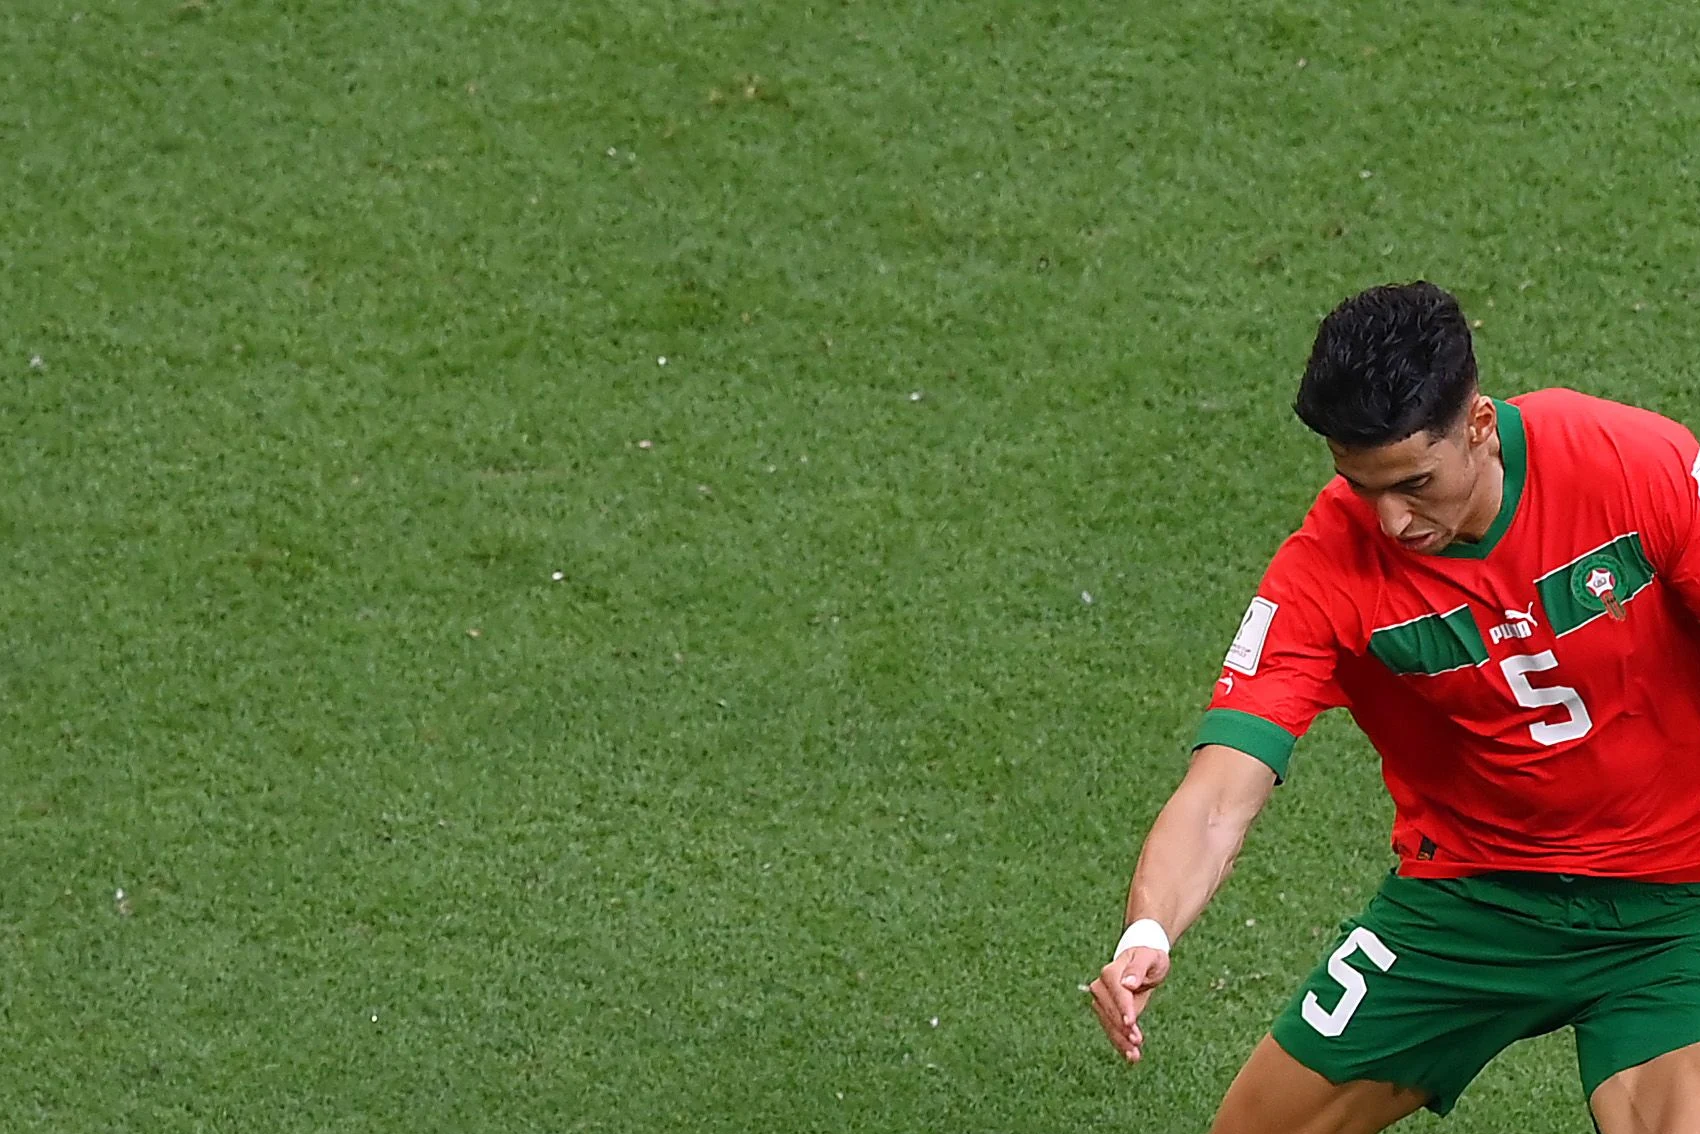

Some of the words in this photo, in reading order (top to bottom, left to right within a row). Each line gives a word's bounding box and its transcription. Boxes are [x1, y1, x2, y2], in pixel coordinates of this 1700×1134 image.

[1489, 621, 1532, 645] PUMA
[1499, 649, 1593, 747] 5
[1301, 926, 1398, 1036] 5
